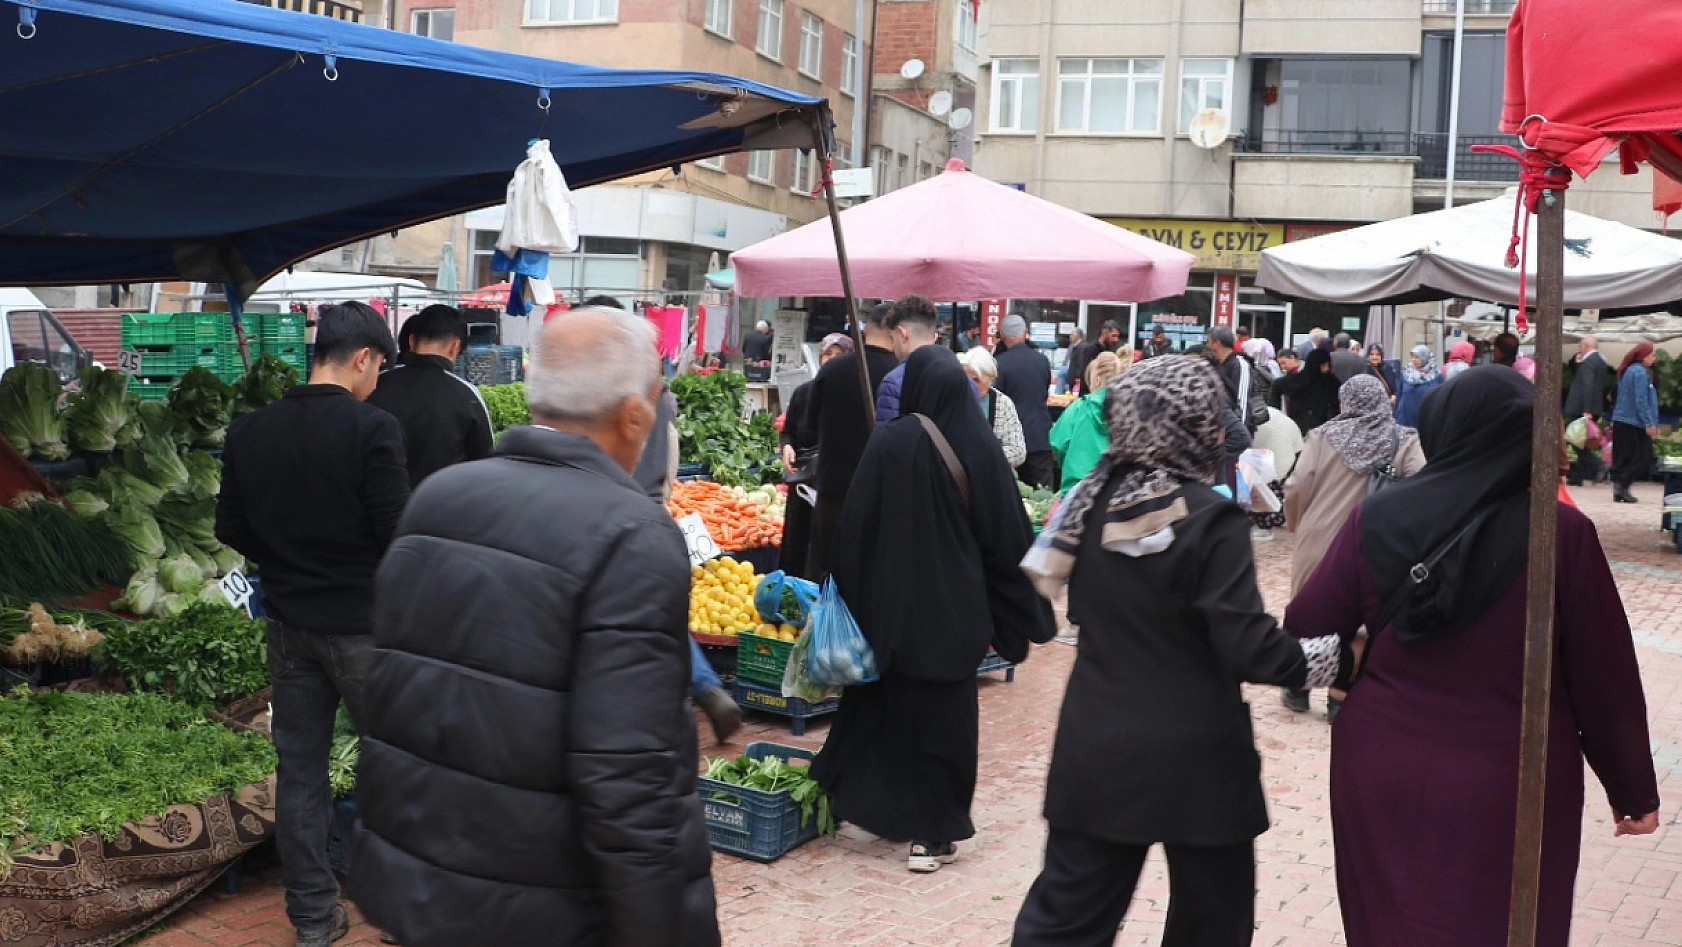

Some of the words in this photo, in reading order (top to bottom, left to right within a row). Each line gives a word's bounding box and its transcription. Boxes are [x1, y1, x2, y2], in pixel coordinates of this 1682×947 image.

[1190, 230, 1206, 249] &
[1213, 225, 1270, 256] ÇEYİZ
[119, 351, 139, 371] 25
[223, 571, 248, 602] 10
